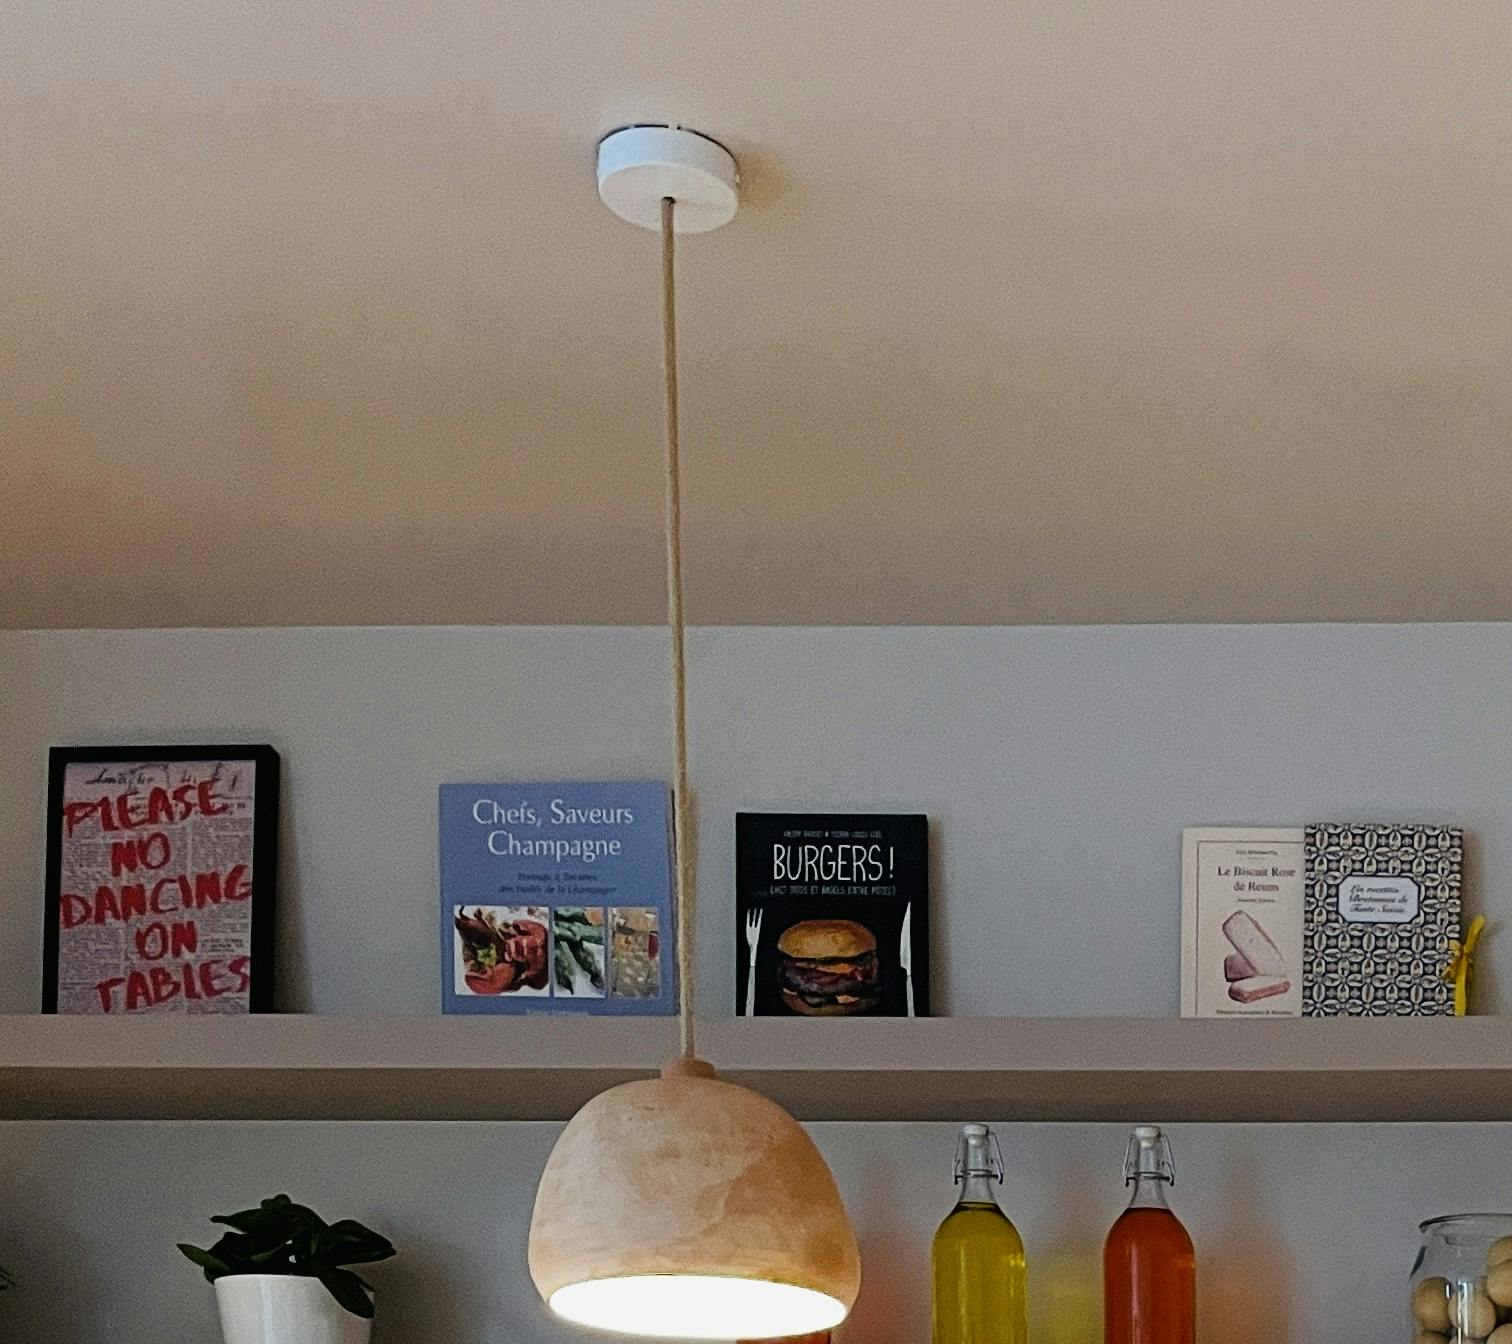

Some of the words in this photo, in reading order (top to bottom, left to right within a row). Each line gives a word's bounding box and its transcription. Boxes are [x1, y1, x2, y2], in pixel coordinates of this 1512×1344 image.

[63, 779, 229, 839] PLEASE
[472, 799, 542, 827] Chefs,
[551, 798, 634, 825] Saveurs
[111, 832, 171, 877] NO
[488, 830, 621, 863] Champagne
[60, 865, 252, 928] DANCING
[136, 920, 198, 960] ON
[96, 956, 251, 1013] TABLES
